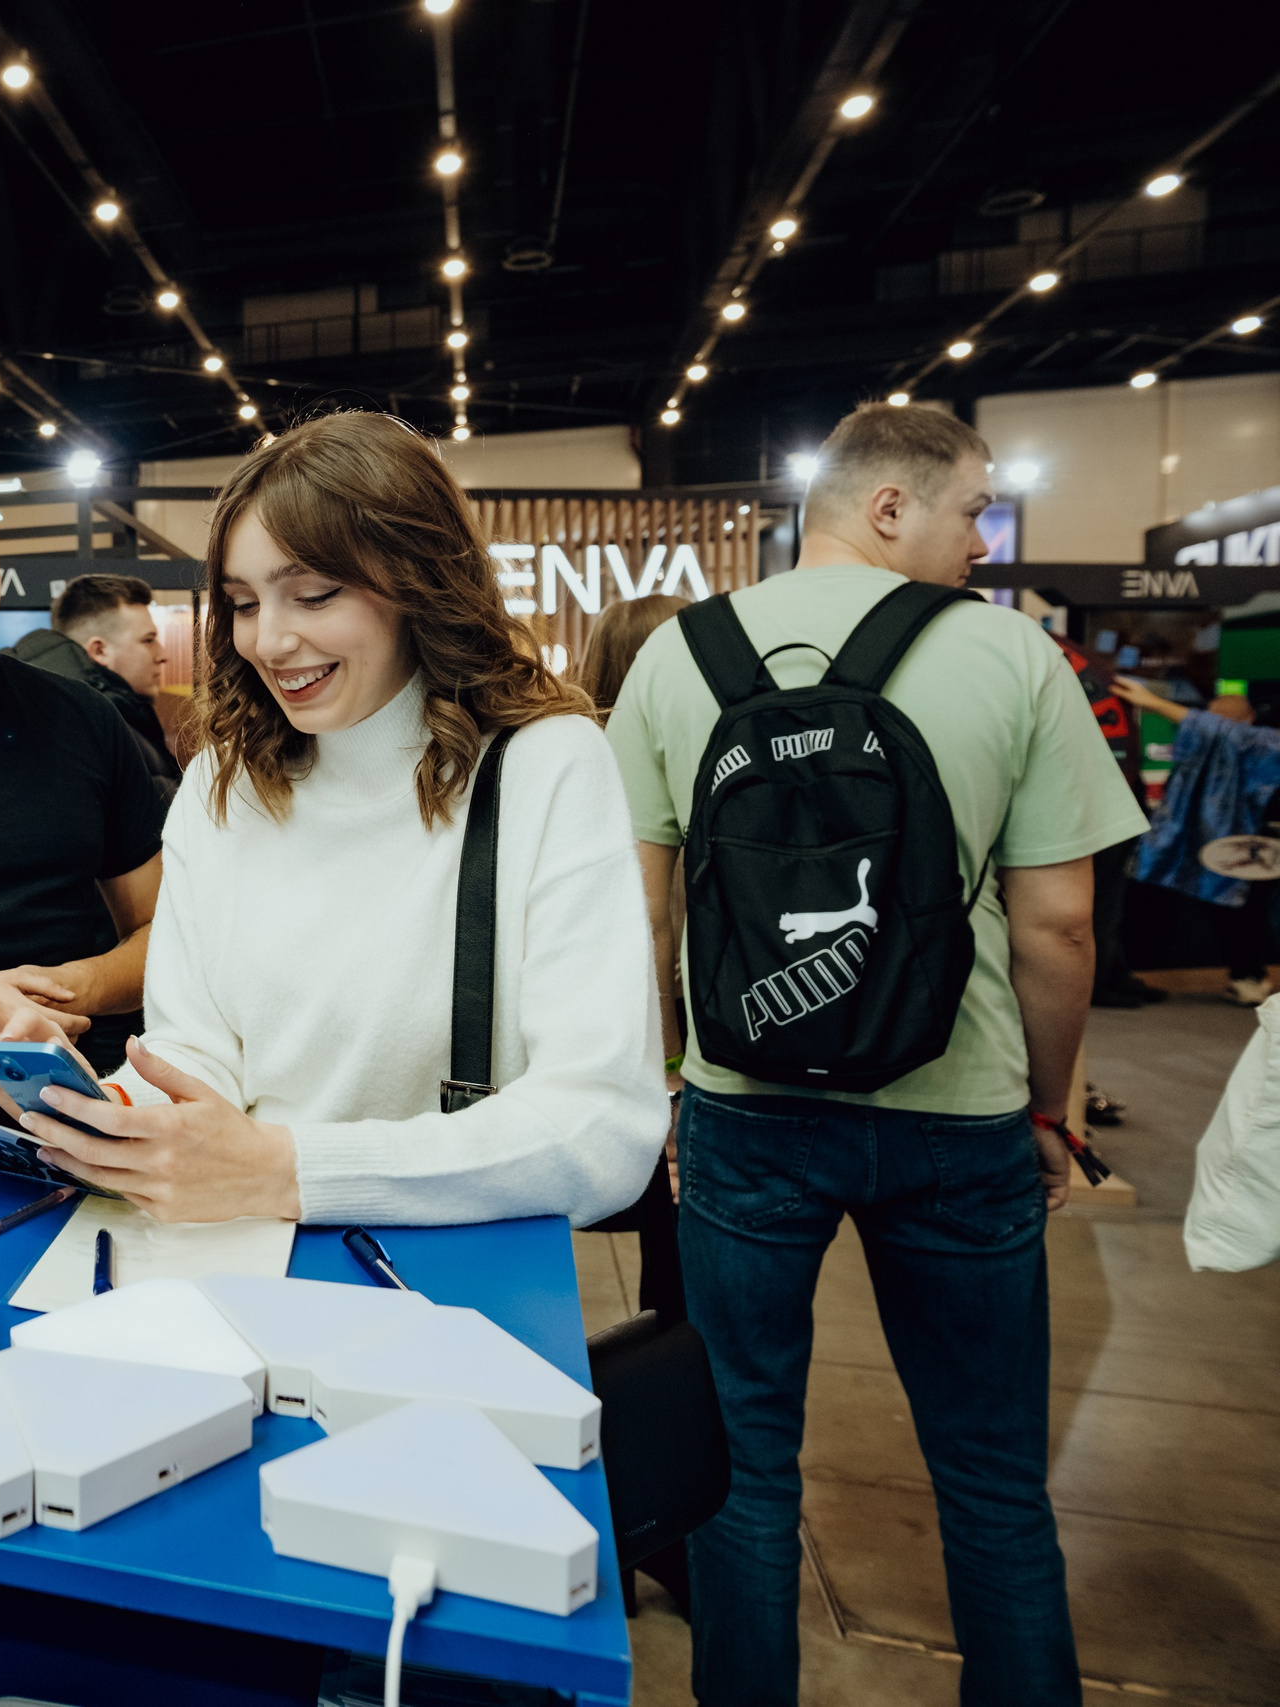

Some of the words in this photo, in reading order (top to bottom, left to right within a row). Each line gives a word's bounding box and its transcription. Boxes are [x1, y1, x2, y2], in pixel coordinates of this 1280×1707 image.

[487, 543, 710, 615] ENVA
[1120, 569, 1200, 599] ENVA
[741, 928, 870, 1041] PUMA
